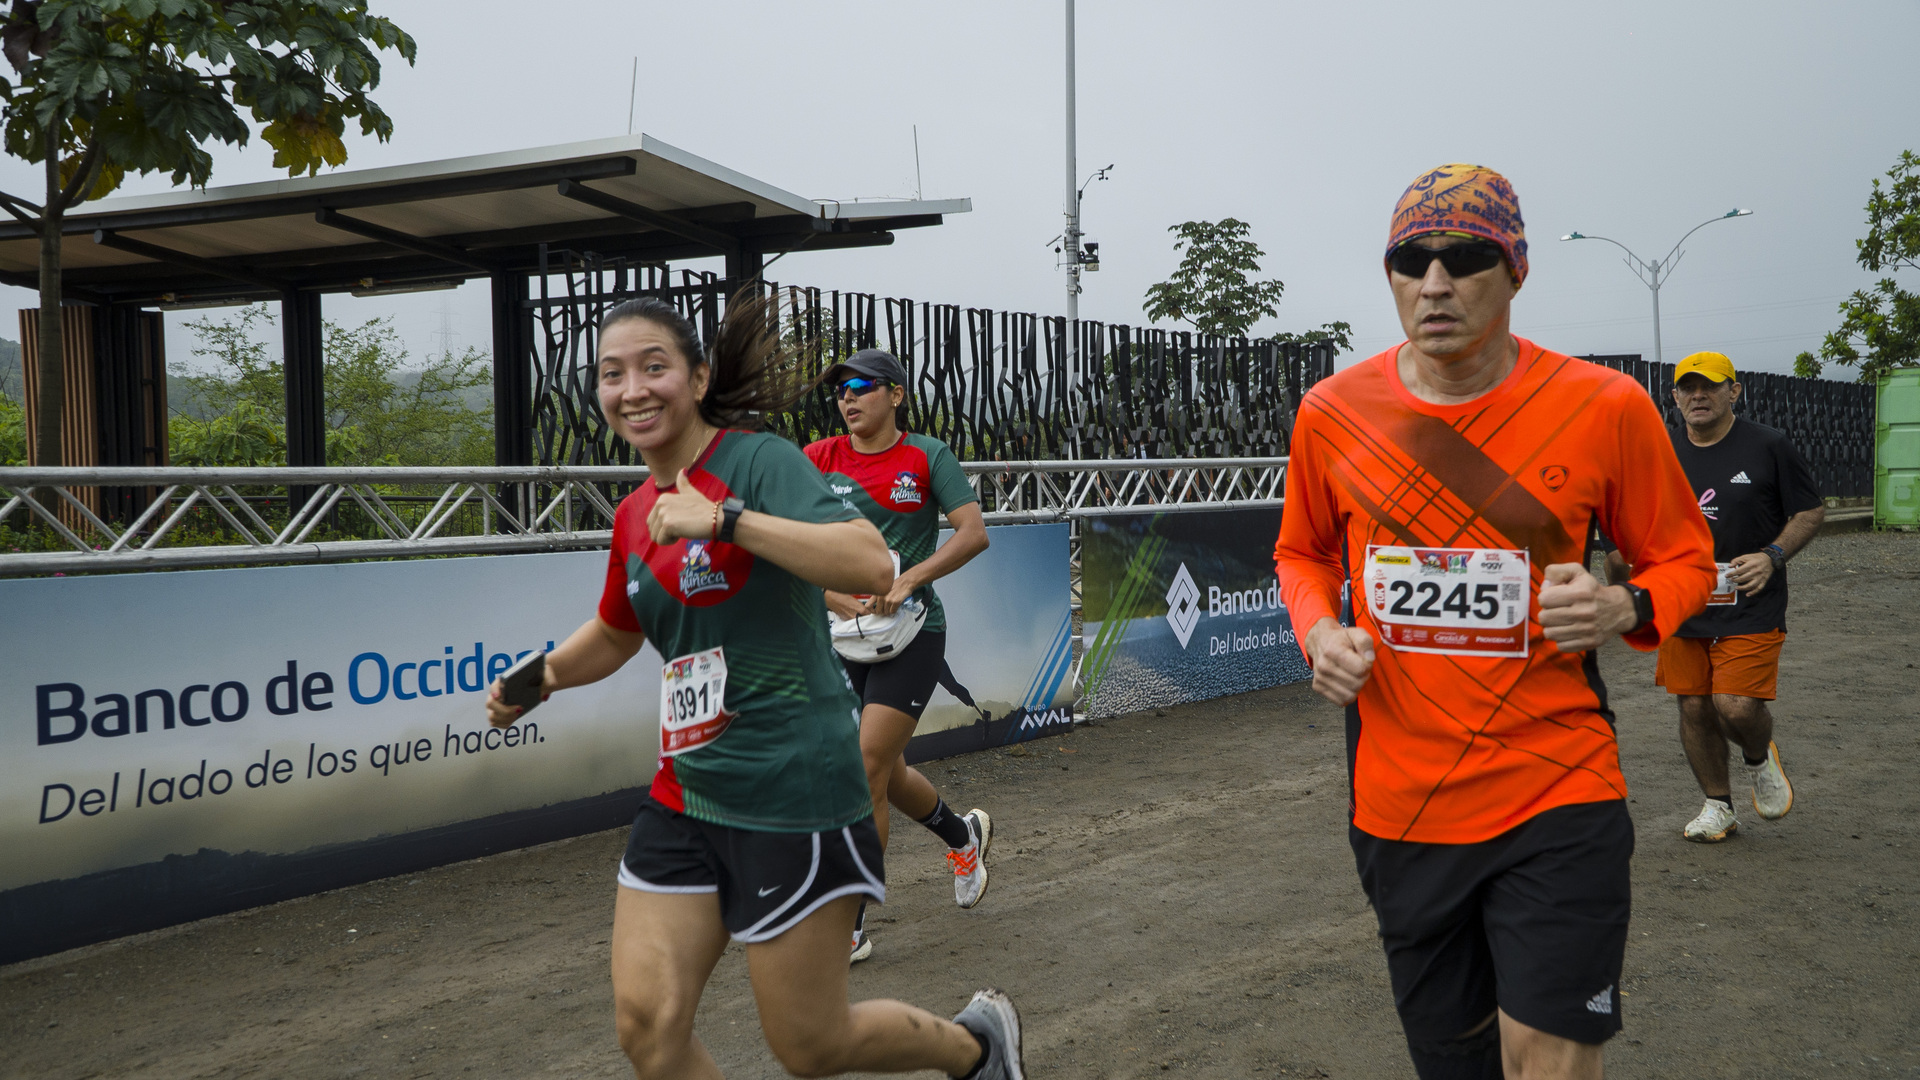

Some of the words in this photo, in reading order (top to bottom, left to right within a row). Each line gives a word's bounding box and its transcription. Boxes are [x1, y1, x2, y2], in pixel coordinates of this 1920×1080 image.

[1208, 586, 1263, 618] Banco
[1389, 580, 1499, 620] 2245
[1210, 633, 1230, 656] Del
[1233, 630, 1259, 652] lado
[1261, 626, 1276, 647] de
[1279, 625, 1296, 645] los
[35, 680, 250, 746] Banco
[265, 660, 335, 716] de
[1020, 707, 1070, 731] AVAL
[1026, 703, 1046, 712] Grupo
[38, 772, 120, 824] Del
[135, 760, 234, 808] lado
[244, 750, 294, 788] de
[306, 743, 358, 779] los
[369, 733, 433, 776] que
[444, 718, 547, 758] hacen.
